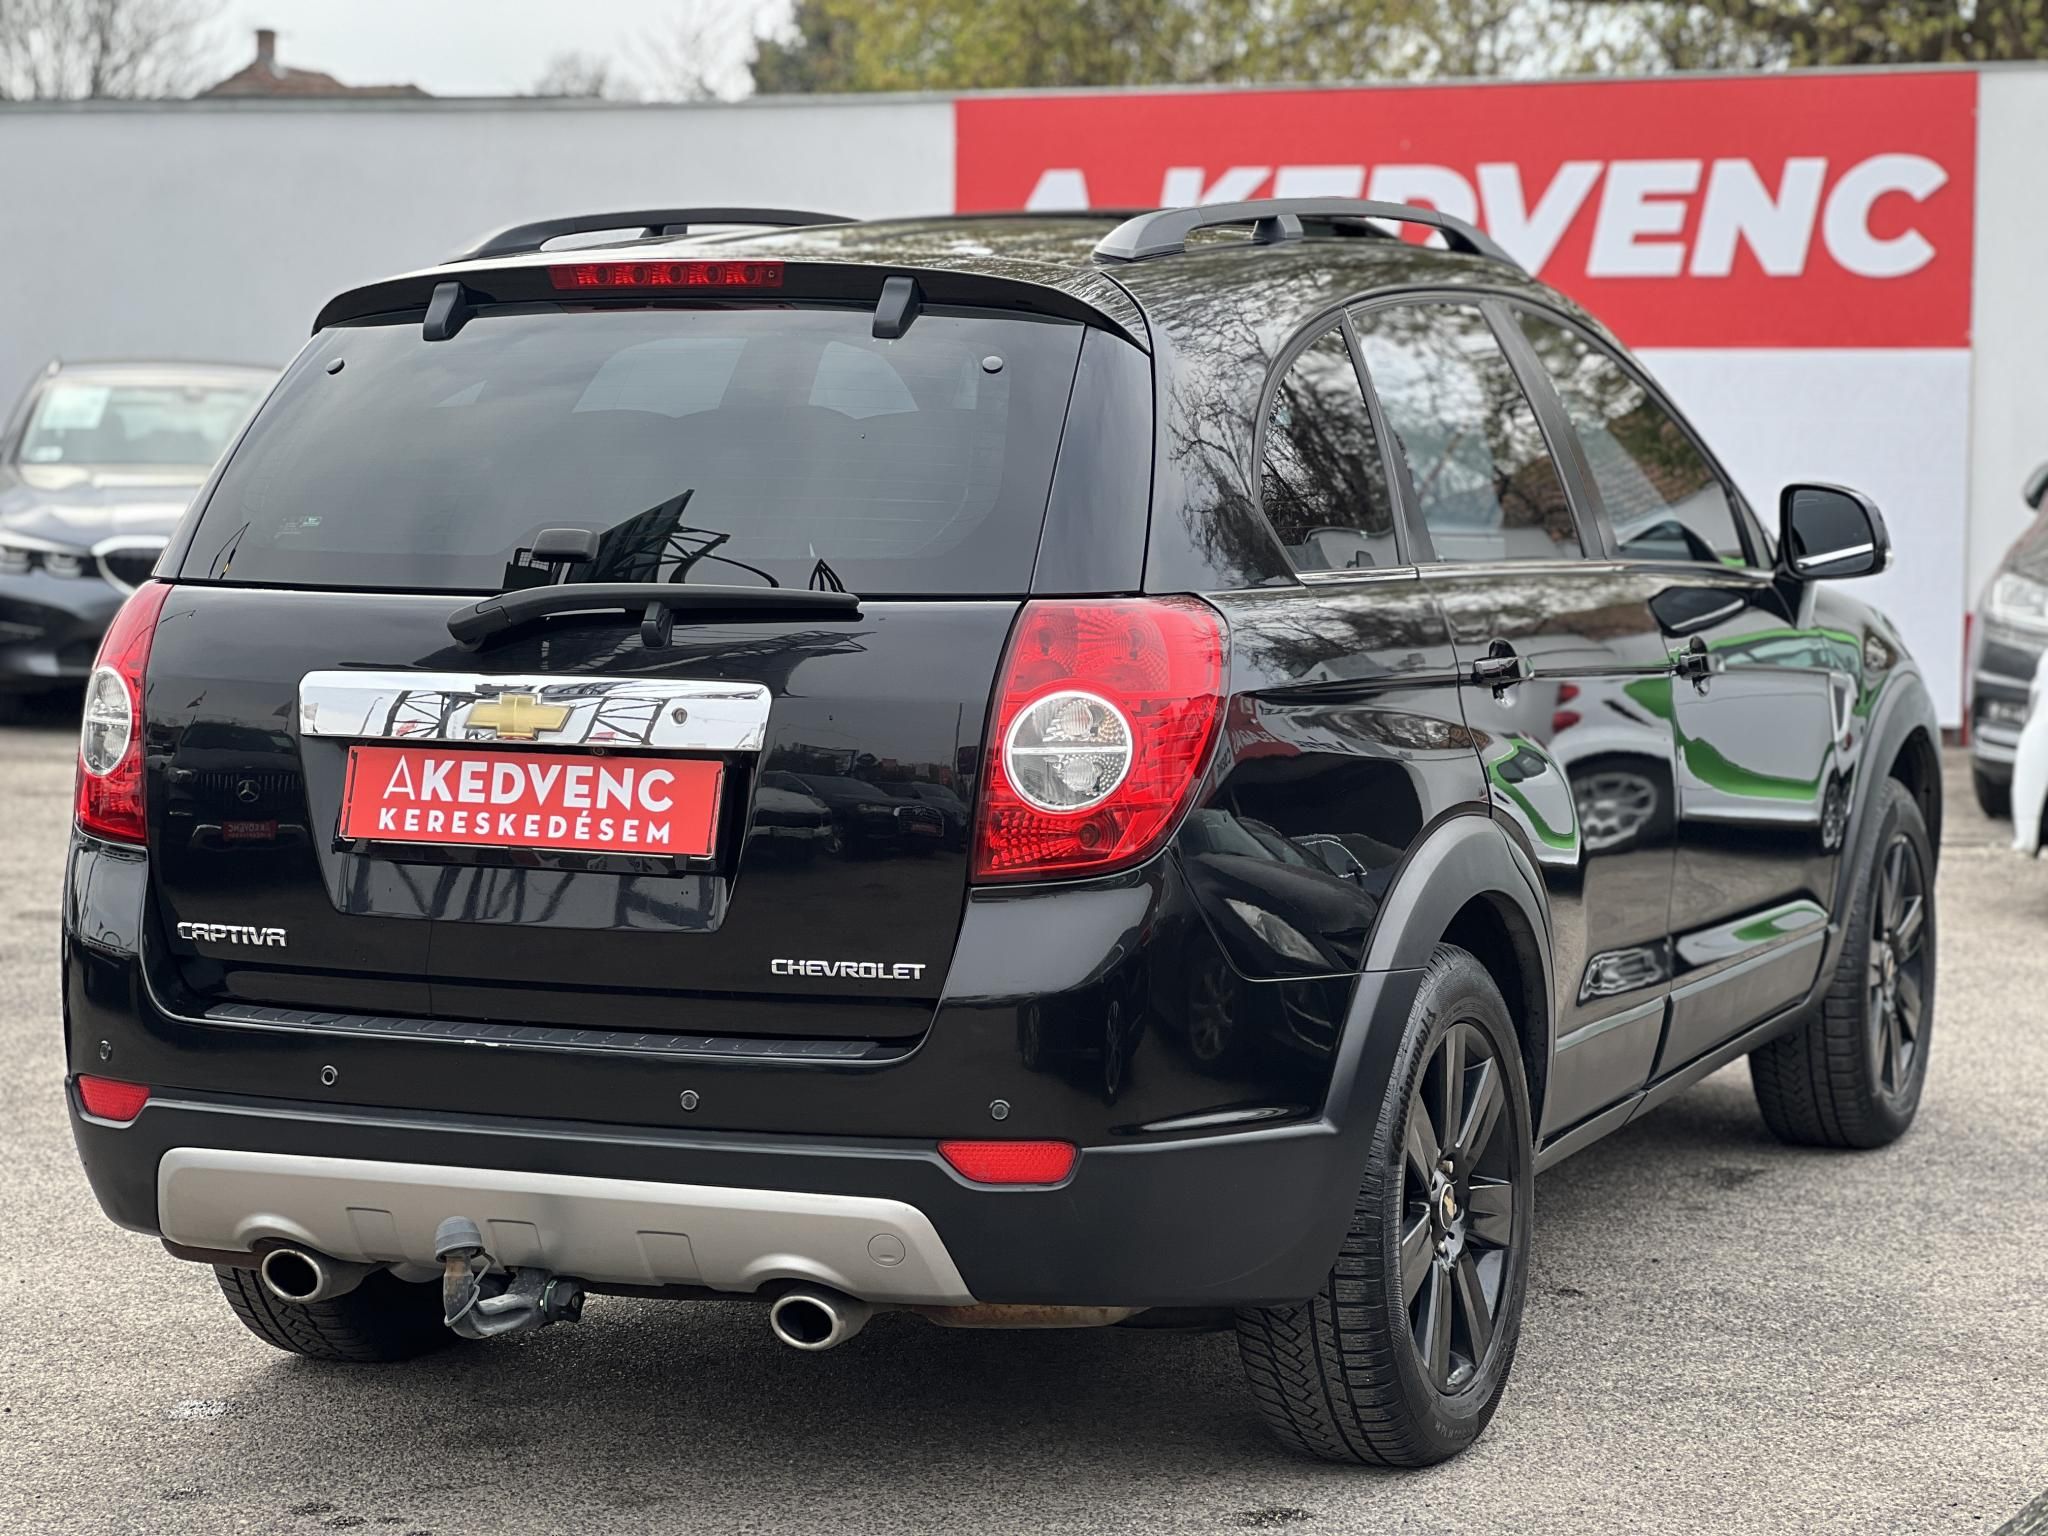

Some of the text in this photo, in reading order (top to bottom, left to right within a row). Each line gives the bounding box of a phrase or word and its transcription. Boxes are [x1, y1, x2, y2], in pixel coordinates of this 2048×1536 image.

[1160, 153, 1947, 278] DVENC
[378, 808, 670, 844] KERESKEDÉSEM
[177, 921, 287, 947] CAPTIVA
[771, 959, 927, 980] CHEVROLET
